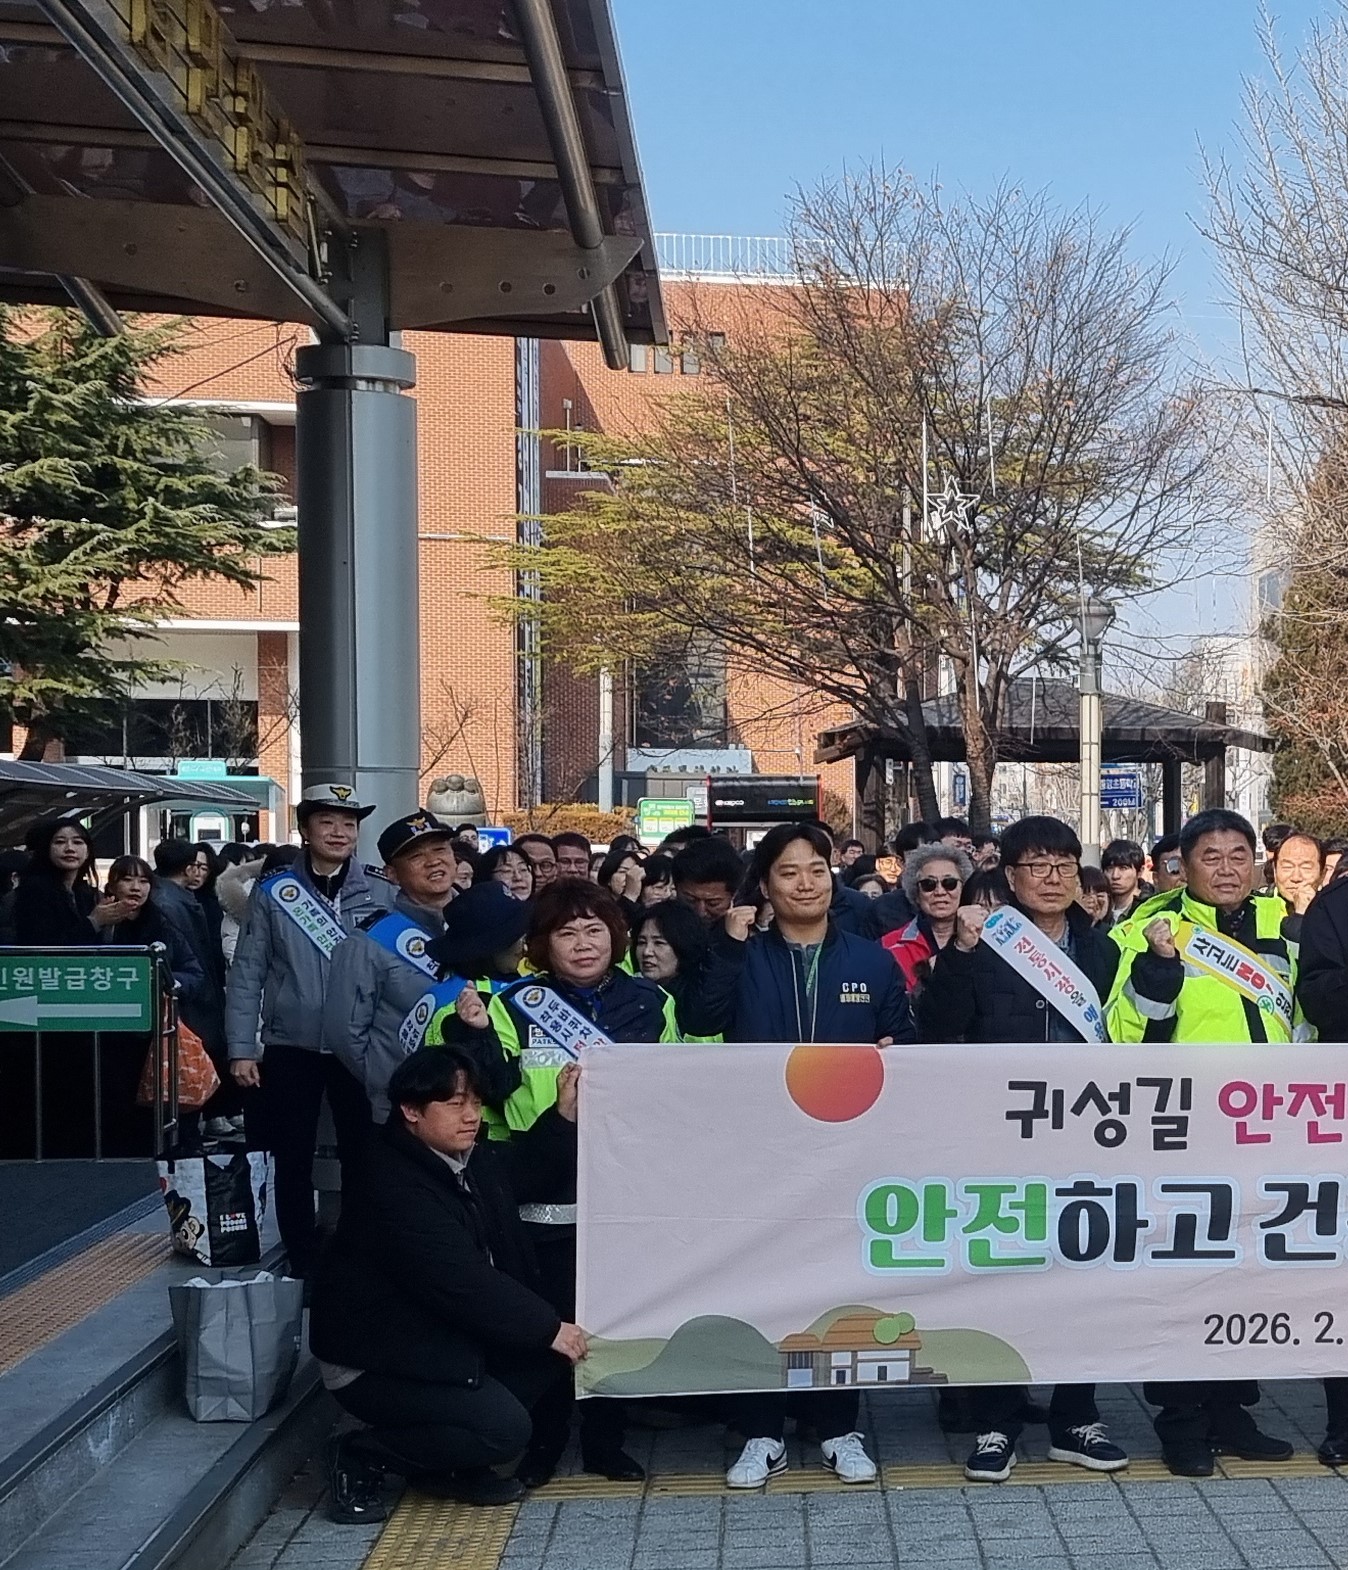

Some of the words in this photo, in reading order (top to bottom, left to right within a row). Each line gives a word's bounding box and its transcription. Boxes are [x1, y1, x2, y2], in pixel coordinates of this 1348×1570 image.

[842, 982, 867, 993] CPO
[1014, 936, 1087, 1007] 전통시장을
[1006, 1077, 1194, 1151] 귀성길
[865, 1181, 1237, 1269] 안전하고
[1203, 1312, 1300, 1347] 2026.
[1314, 1312, 1344, 1346] 2.
